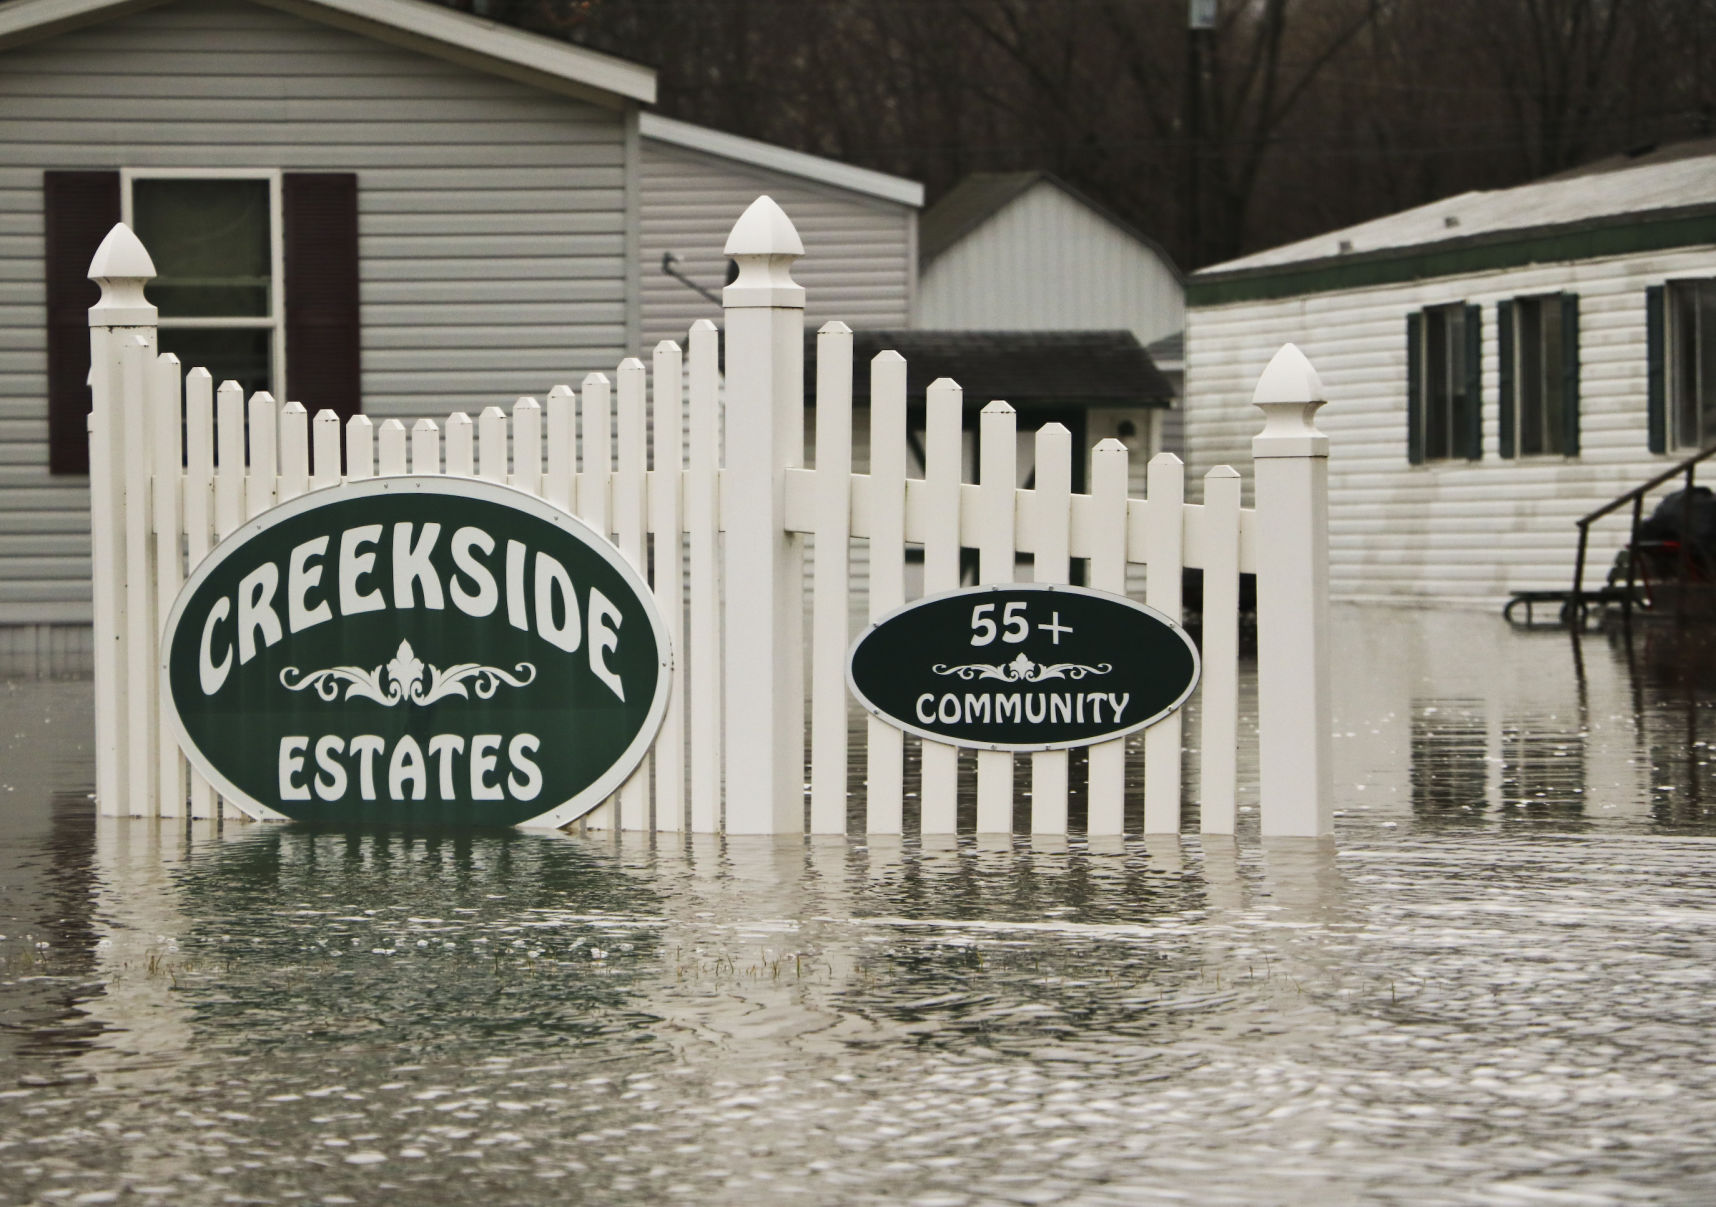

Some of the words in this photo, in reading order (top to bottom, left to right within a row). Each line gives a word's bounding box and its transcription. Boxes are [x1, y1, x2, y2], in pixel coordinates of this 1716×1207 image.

[199, 521, 626, 703] CREEKSIDE
[970, 601, 1073, 647] 55+
[915, 692, 1130, 724] COMMUNITY
[278, 733, 543, 802] ESTATES
